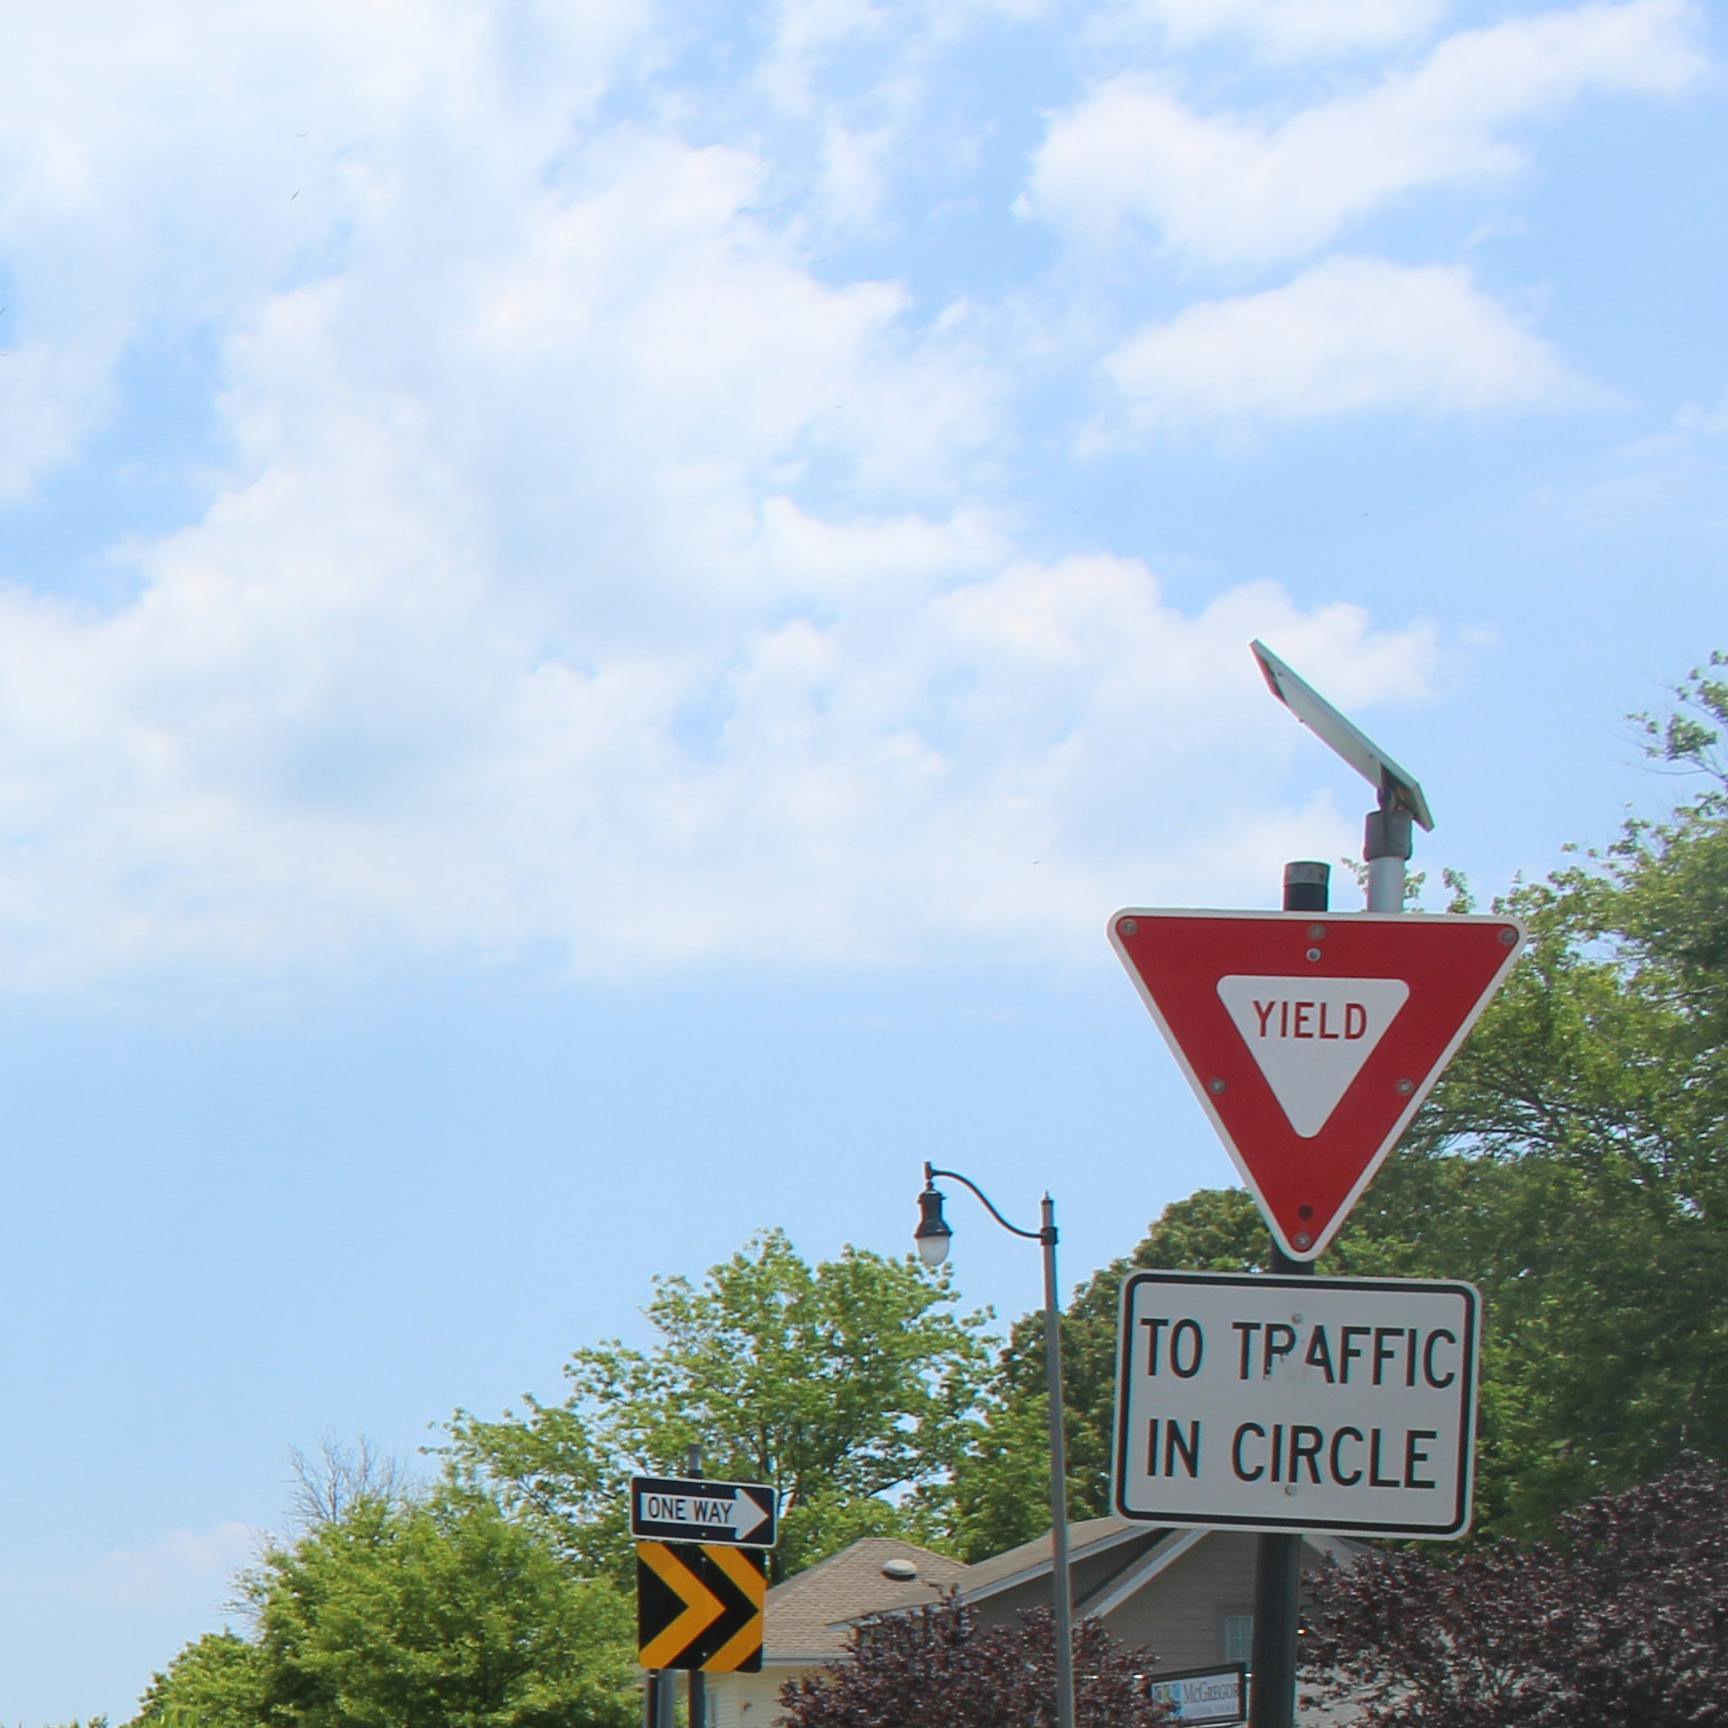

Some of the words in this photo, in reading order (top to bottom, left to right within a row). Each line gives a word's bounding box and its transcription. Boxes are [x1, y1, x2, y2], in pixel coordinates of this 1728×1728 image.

[1252, 1000, 1368, 1040] YIELD
[1140, 1317, 1204, 1379] TO
[1146, 1418, 1201, 1479] IN
[1231, 1422, 1438, 1489] CIRCLE
[647, 1496, 687, 1521] ONE
[693, 1499, 733, 1524] WAY
